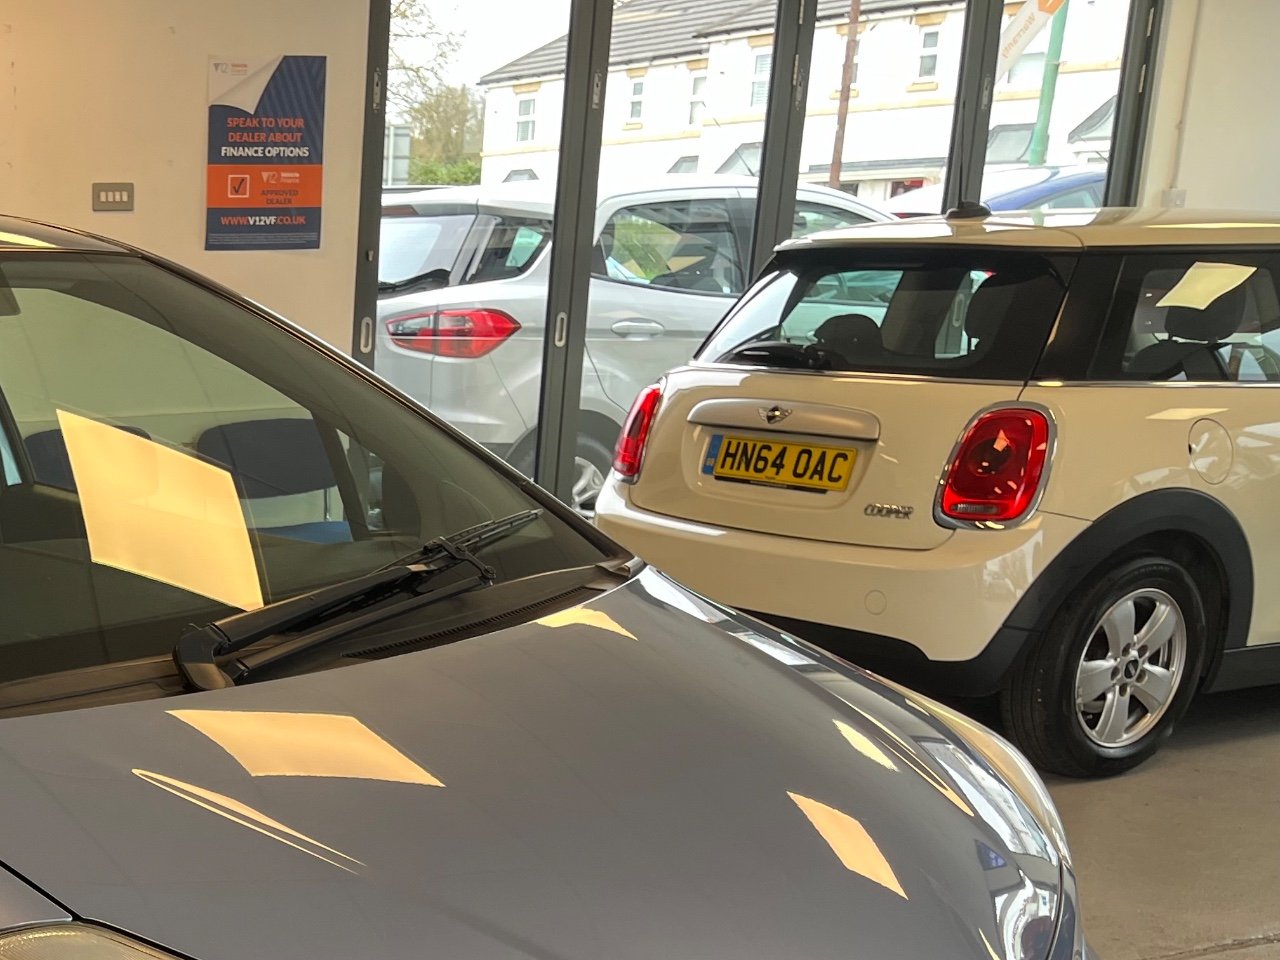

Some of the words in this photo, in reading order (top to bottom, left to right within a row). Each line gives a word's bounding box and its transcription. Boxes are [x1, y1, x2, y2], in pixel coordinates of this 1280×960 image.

[227, 117, 260, 128] SPEAK
[261, 117, 276, 128] TO
[277, 117, 306, 128] YOUR
[228, 132, 267, 142] DEALER
[268, 132, 304, 142] ABOUT
[221, 146, 264, 157] FINANCE
[264, 146, 310, 157] OPTIONS
[261, 189, 299, 197] APPROVED
[220, 215, 306, 226] WWW.V12VF.CO.UK
[720, 440, 788, 476] HN64
[791, 448, 849, 483] OAC
[864, 503, 914, 520] COOPER
